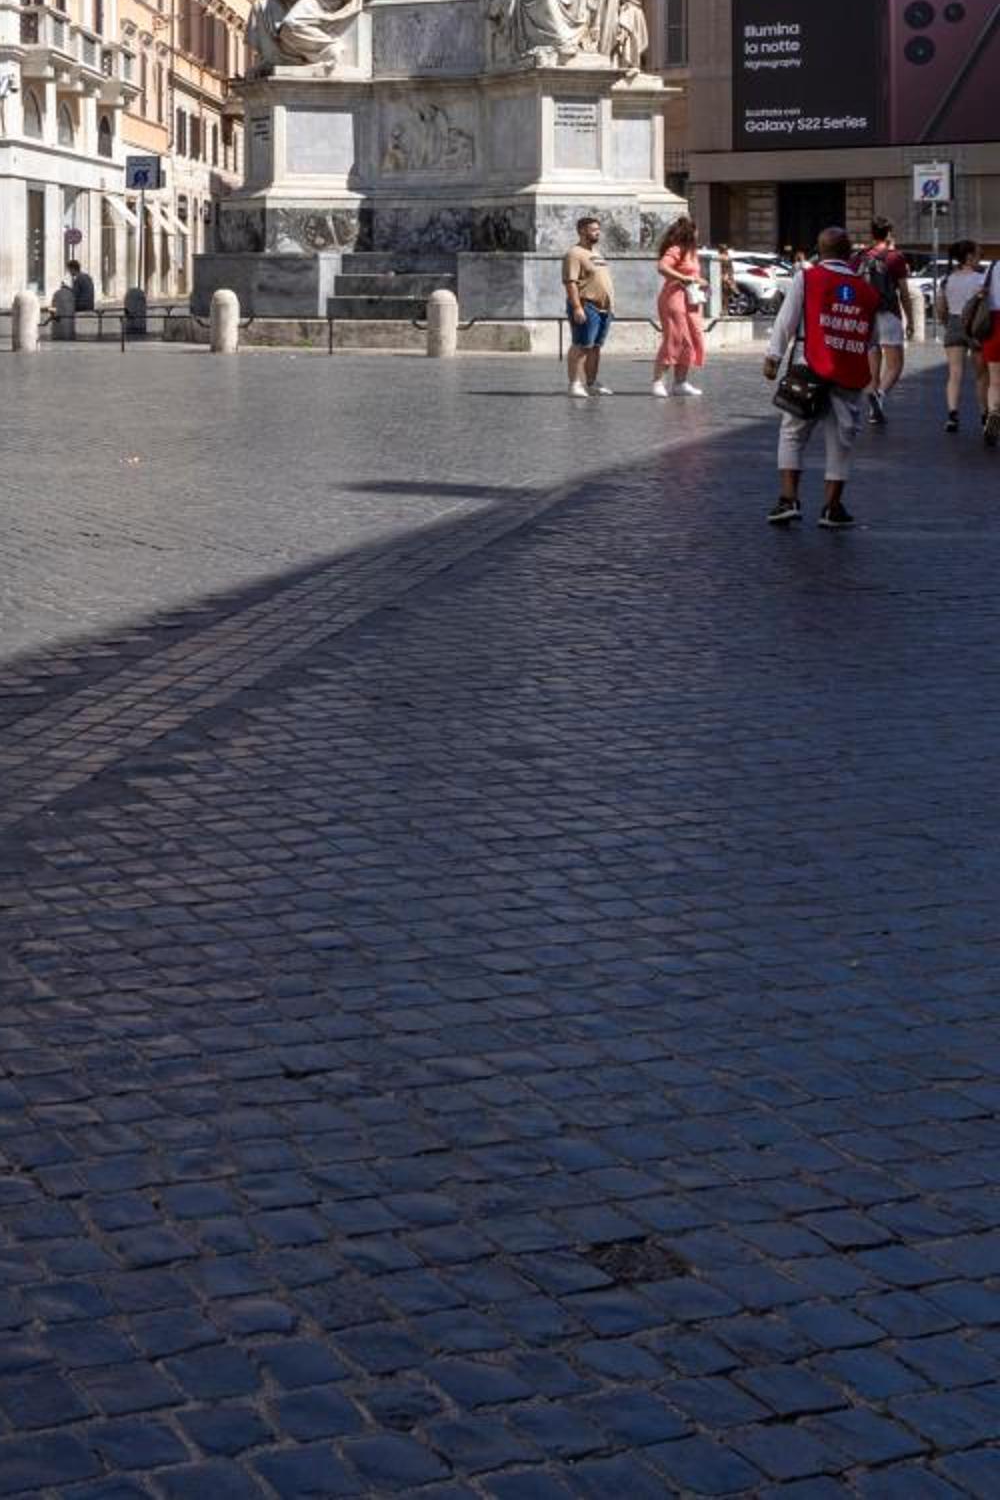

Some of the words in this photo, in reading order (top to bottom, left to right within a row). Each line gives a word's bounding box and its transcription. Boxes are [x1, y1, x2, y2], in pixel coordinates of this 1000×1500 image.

[744, 22, 800, 37] Illumina
[744, 41, 758, 54] la
[761, 40, 800, 53] notte
[745, 120, 795, 133] Galaxy
[797, 117, 821, 131] S22
[823, 115, 867, 129] Series
